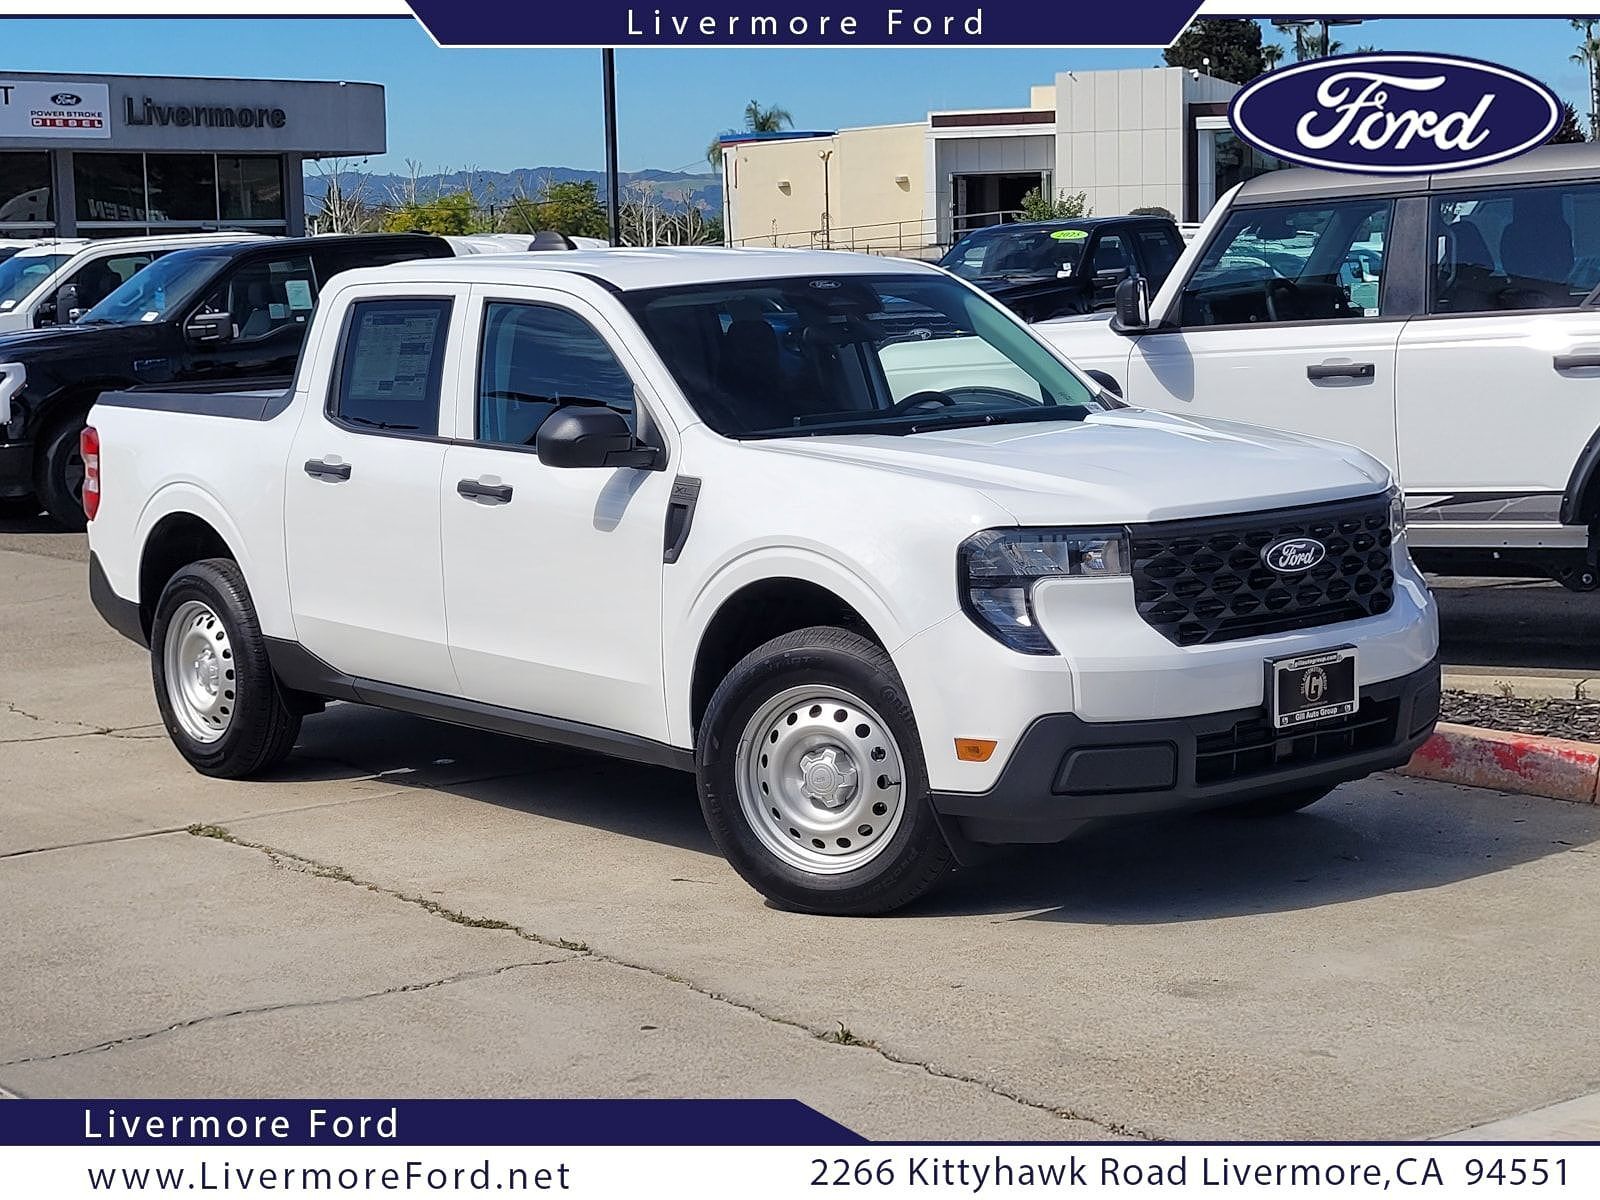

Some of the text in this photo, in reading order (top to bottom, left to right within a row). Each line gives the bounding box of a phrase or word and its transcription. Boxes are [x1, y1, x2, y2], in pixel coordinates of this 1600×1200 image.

[31, 110, 65, 118] POWER
[124, 96, 287, 128] Livermore
[1279, 543, 1315, 568] Ford
[1295, 707, 1338, 721] Gill Auto Group
